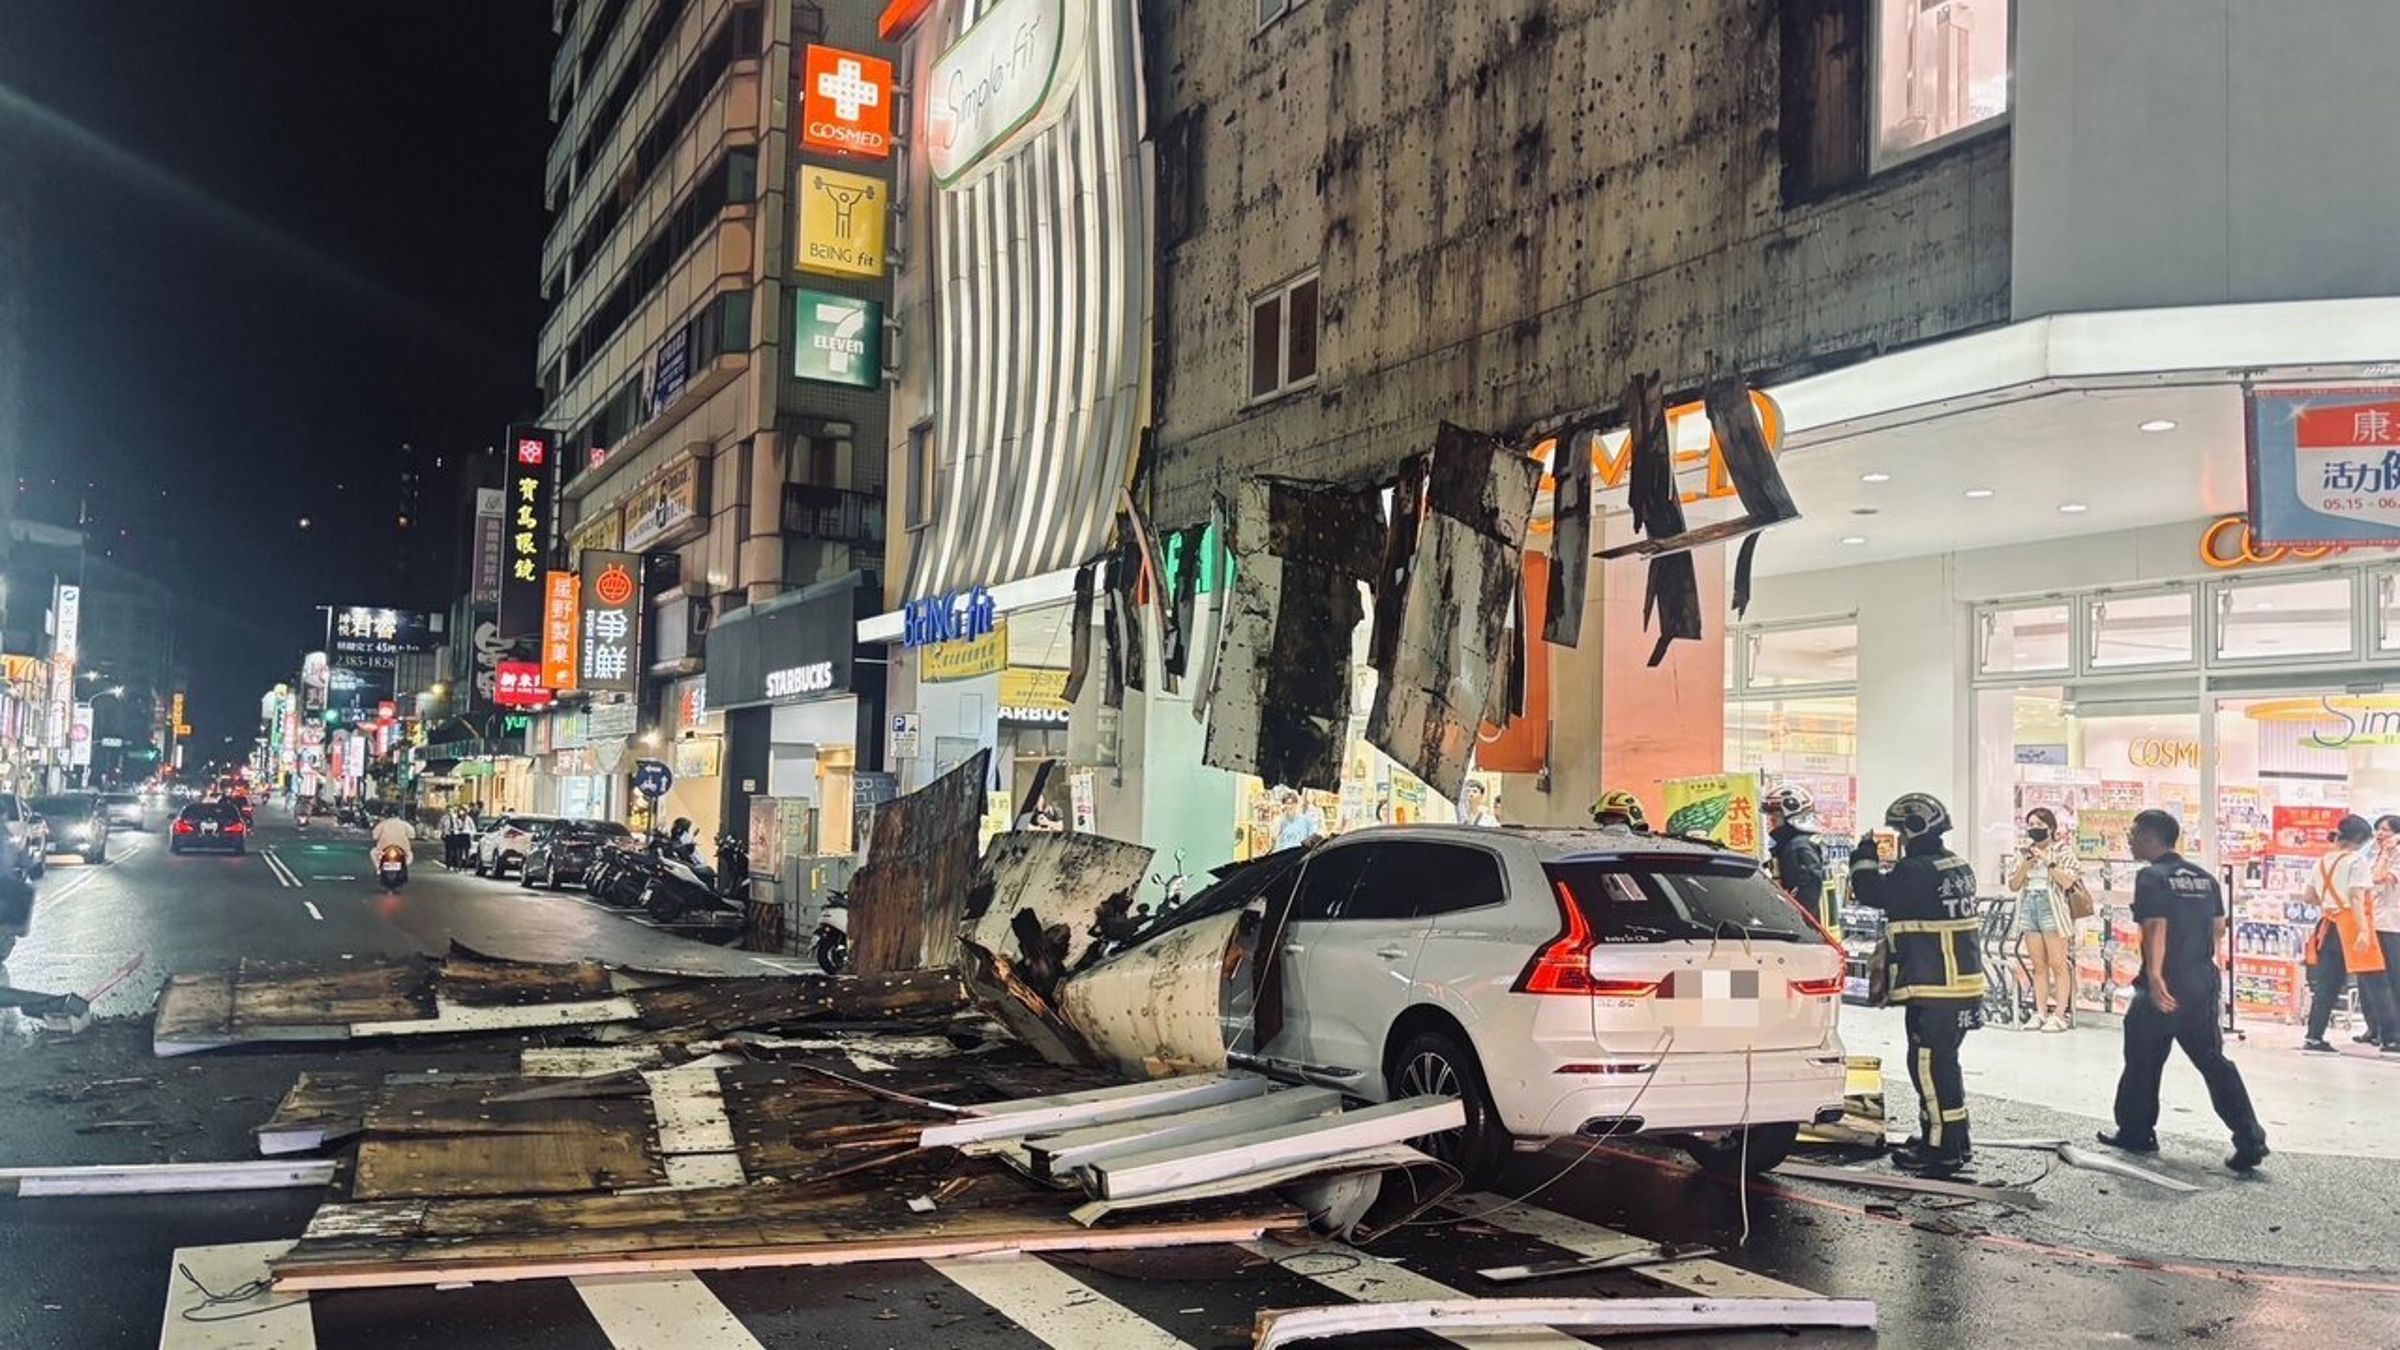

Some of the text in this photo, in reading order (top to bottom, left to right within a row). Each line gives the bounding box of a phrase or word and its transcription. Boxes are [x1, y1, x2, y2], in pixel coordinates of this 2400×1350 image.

[809, 121, 883, 148] COSMED
[857, 251, 875, 268] fit
[816, 303, 864, 374] 7
[765, 661, 833, 697] STARBUCKS
